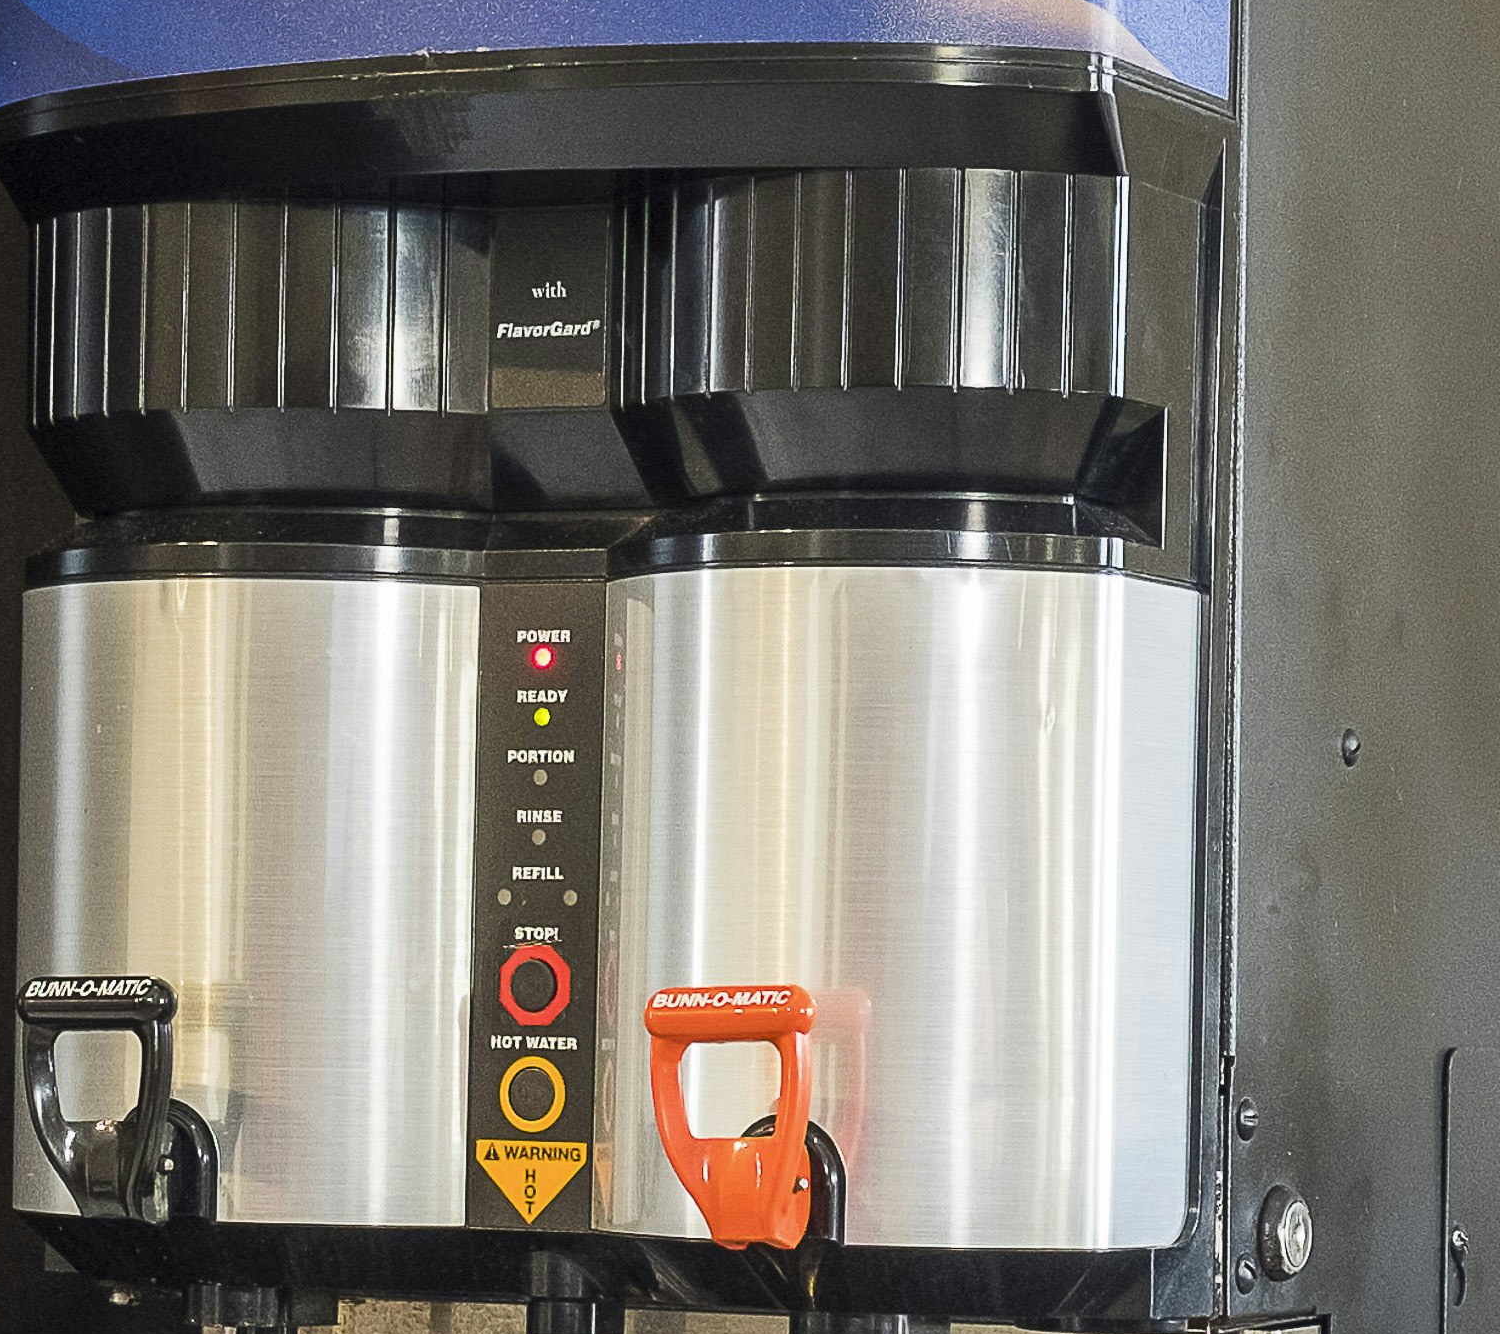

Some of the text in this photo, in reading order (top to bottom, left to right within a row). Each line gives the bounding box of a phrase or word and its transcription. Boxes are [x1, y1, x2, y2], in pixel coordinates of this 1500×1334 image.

[531, 280, 567, 299] with
[516, 629, 571, 644] POWER
[516, 689, 568, 704] READY
[507, 749, 575, 764] PORTION
[516, 810, 563, 824] RINSE
[512, 866, 565, 881] REFILL
[25, 978, 152, 998] BUNN-O-MATIC
[651, 990, 791, 1008] BUNN-O-MATIC
[490, 1035, 578, 1051] HOT WATER
[504, 1145, 581, 1163] WARNING
